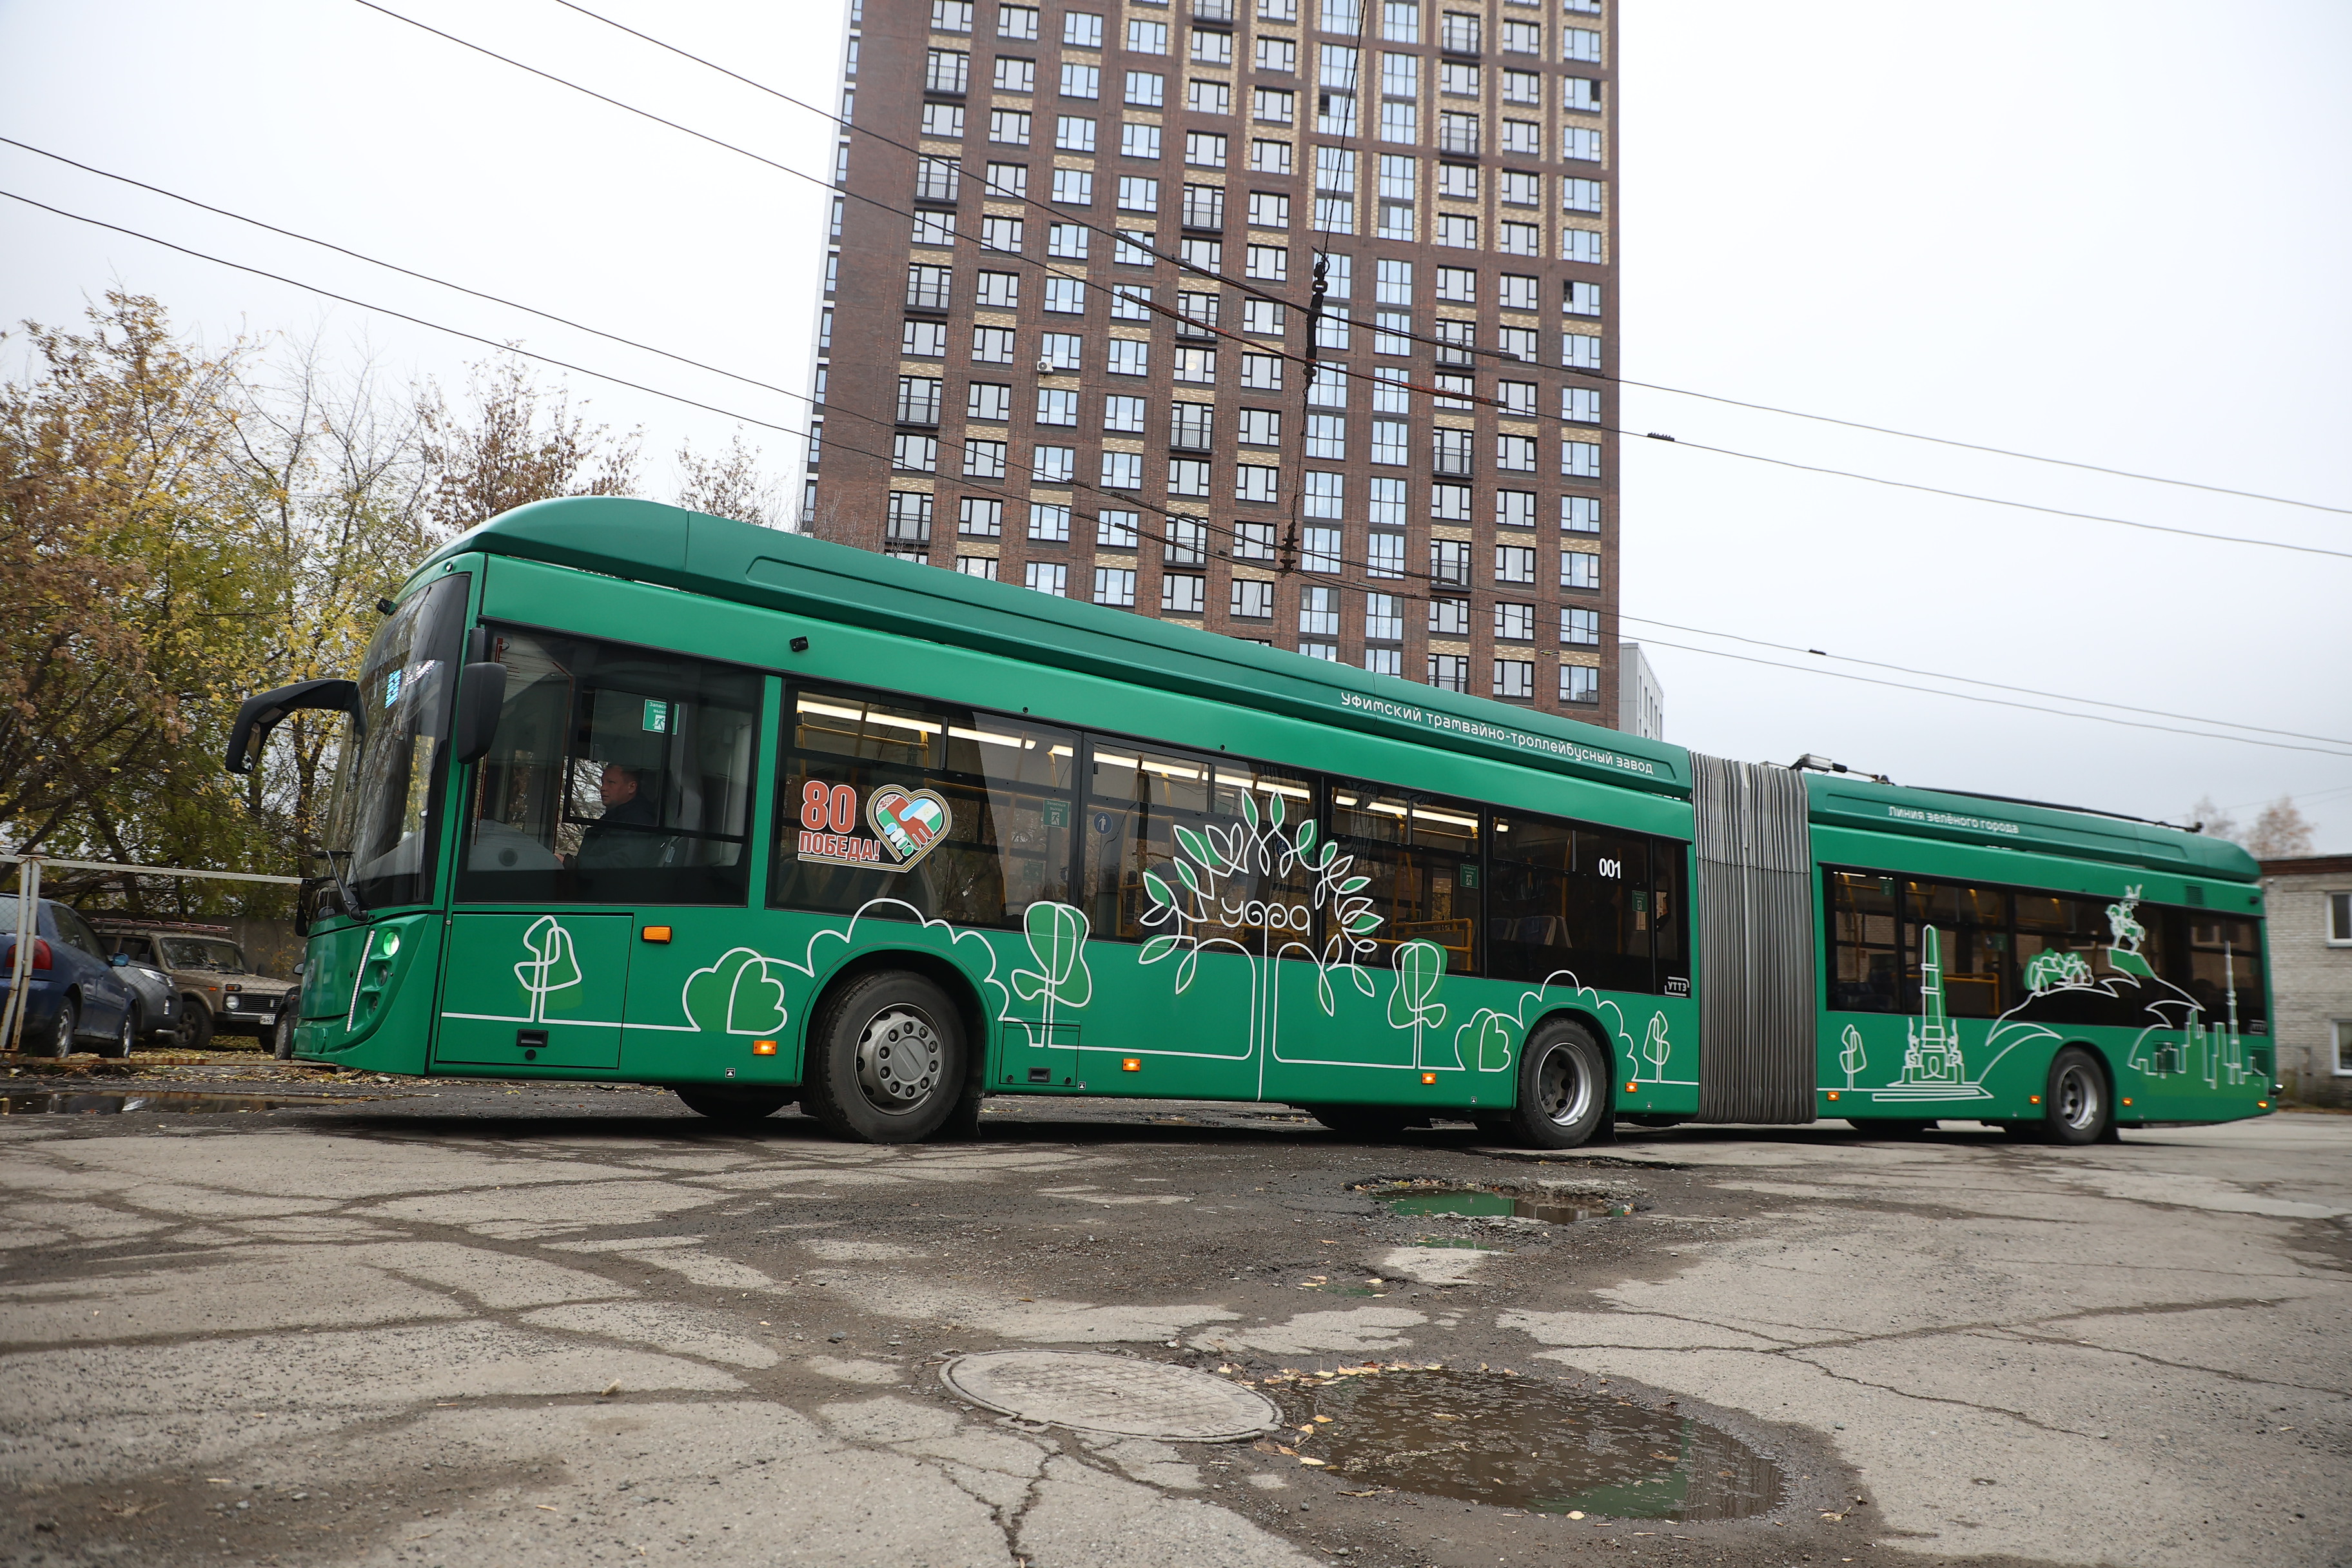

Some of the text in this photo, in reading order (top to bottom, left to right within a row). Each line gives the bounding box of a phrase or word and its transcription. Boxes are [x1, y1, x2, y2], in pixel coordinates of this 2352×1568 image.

[1341, 692, 1654, 776] Уфимский трамвайно-троллейбусный завод
[801, 780, 856, 834] 80
[1888, 806, 2020, 834] Линия зелёного города
[799, 830, 881, 863] ПОБЕДА!
[1599, 858, 1621, 879] 001
